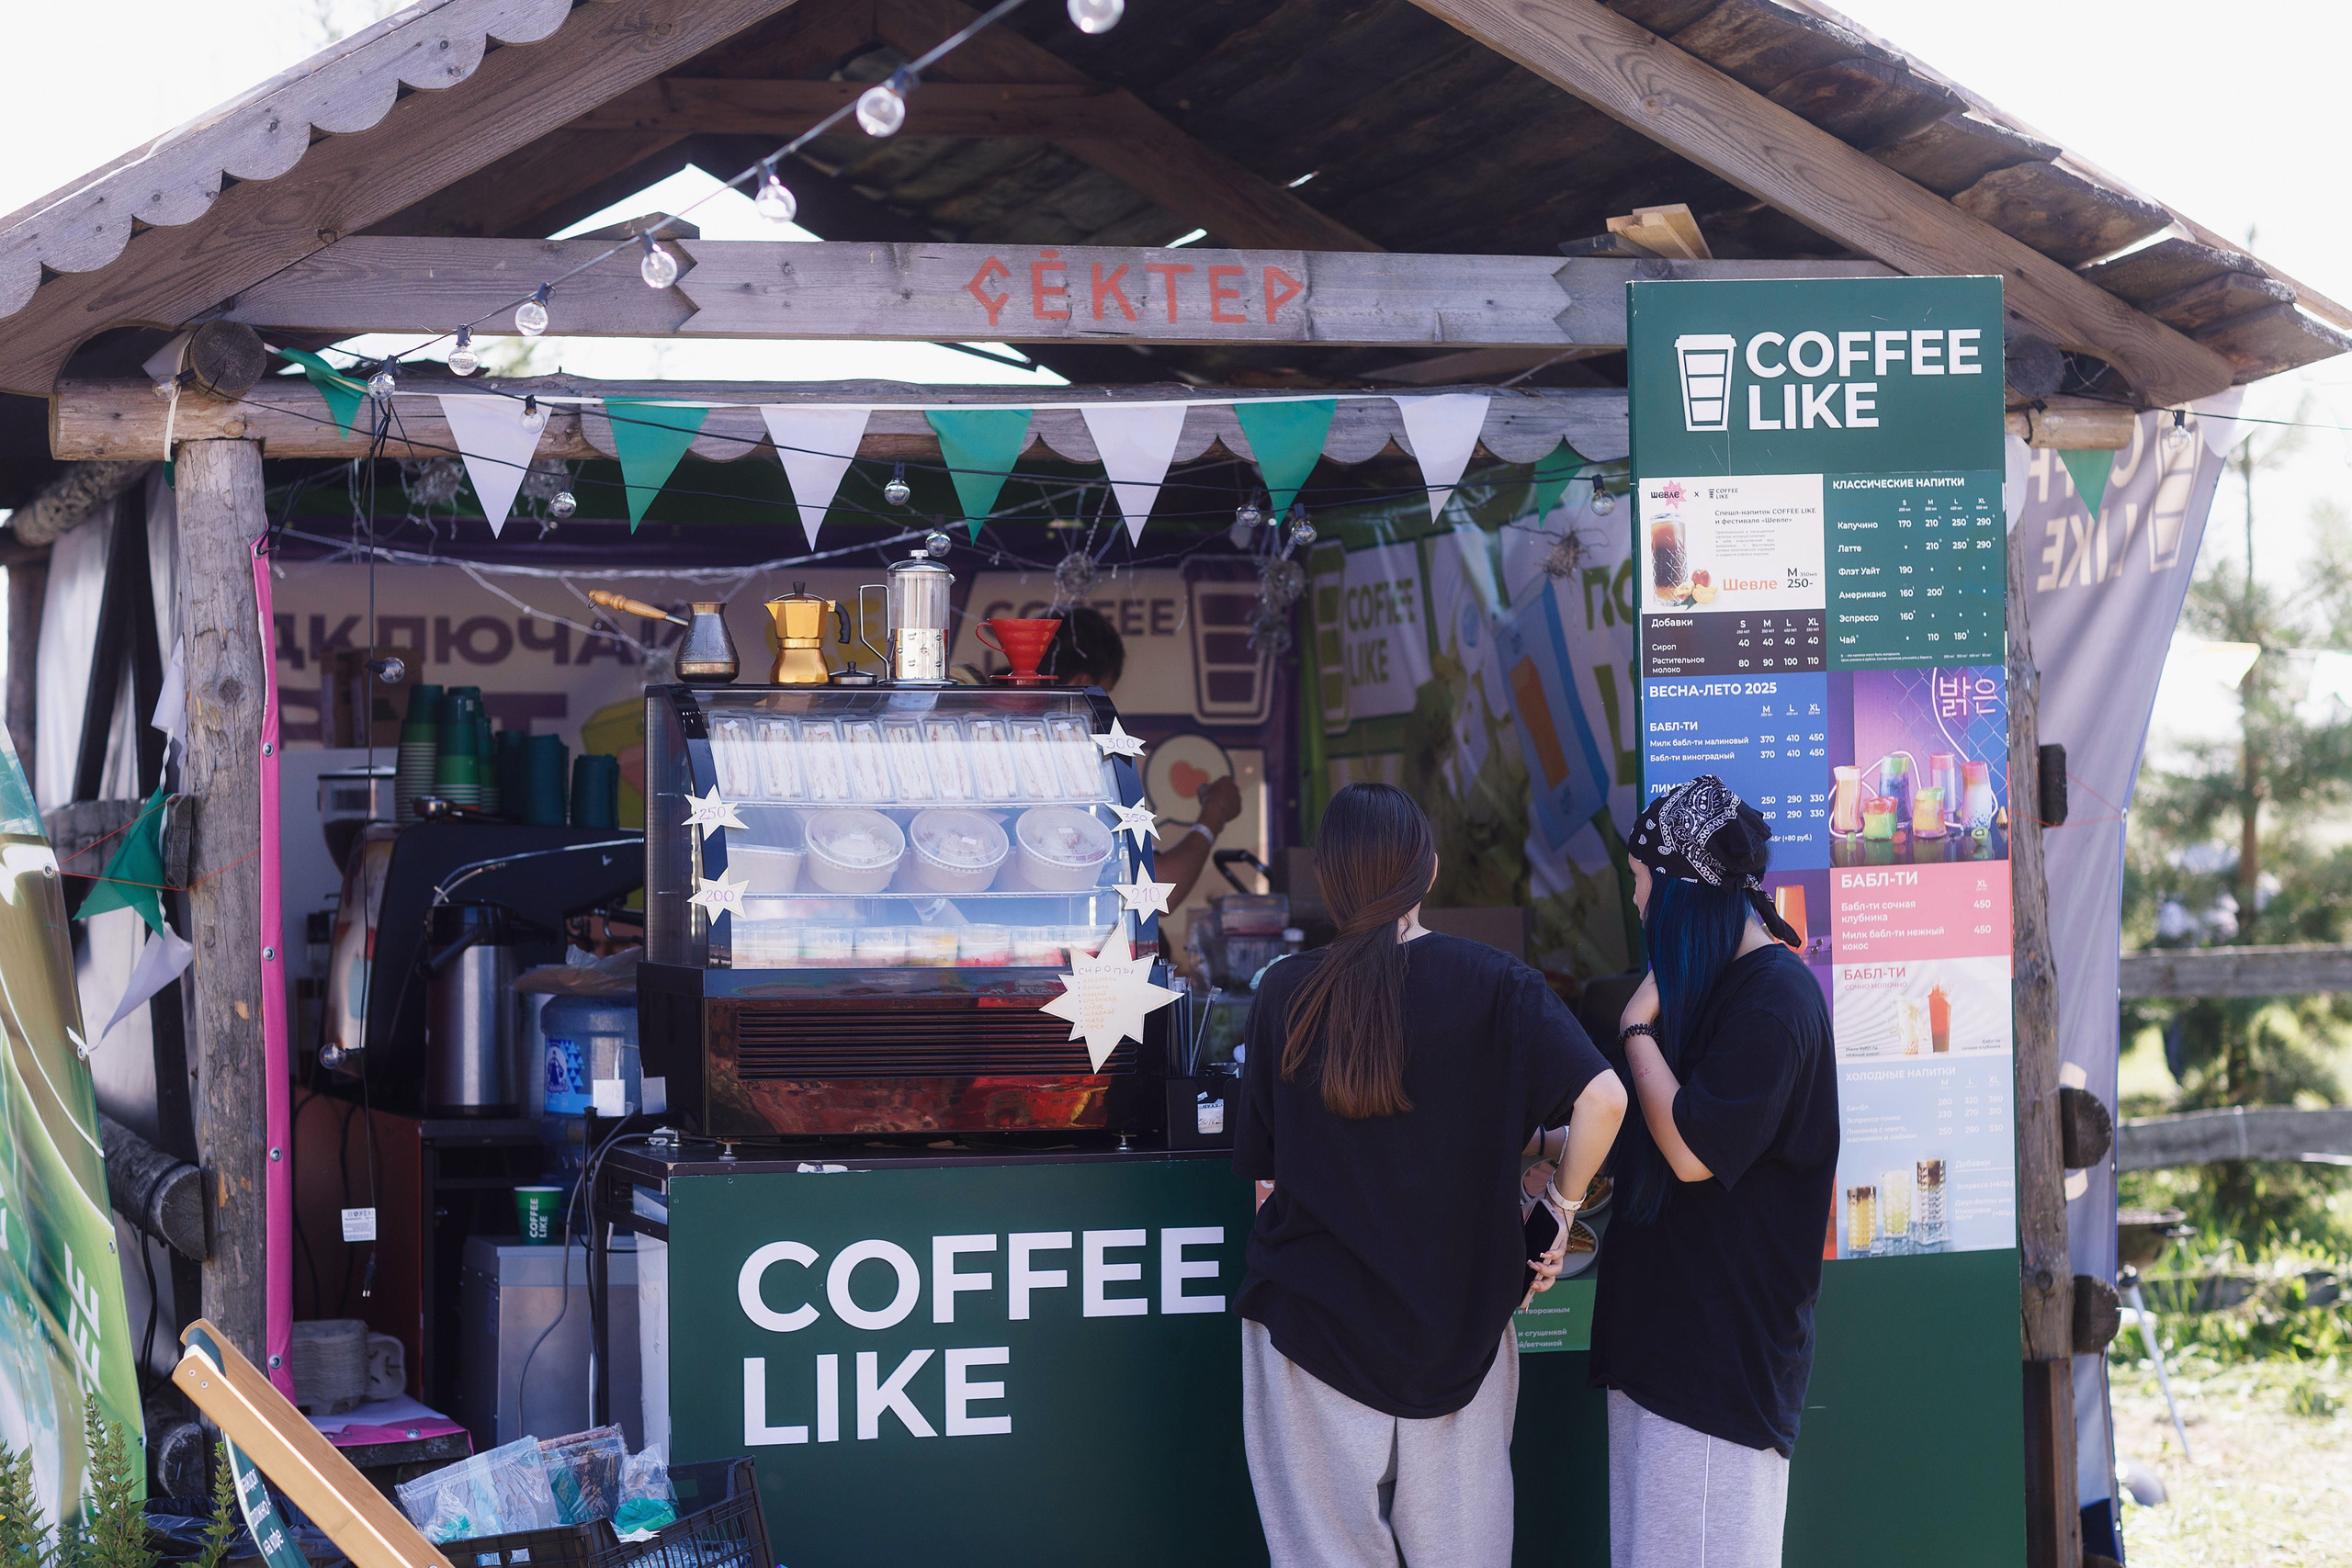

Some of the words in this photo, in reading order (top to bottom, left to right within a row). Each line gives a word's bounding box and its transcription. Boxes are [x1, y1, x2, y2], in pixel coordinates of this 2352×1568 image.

[1746, 329, 1983, 378] COFFEE
[1747, 382, 1880, 430] LIKE
[1832, 479, 1915, 490] КЛАССИЧЕСКИЕ
[1916, 477, 1965, 488] НАПИТКИ
[1838, 521, 1879, 530] Капучино
[1898, 520, 1912, 528] 170
[1838, 544, 1862, 553] Латте
[1838, 568, 1860, 576] Флэт
[1860, 567, 1881, 575] Уайт
[1899, 566, 1913, 574] 190
[1723, 578, 1778, 591] Шевле
[1838, 591, 1887, 600] Американо
[1651, 618, 1693, 629] Добавки
[1740, 620, 1746, 628] S
[1763, 619, 1771, 627] M
[1808, 618, 1819, 626] XL
[1839, 615, 1879, 623] Эспрессо
[1784, 637, 1795, 646] 40
[1807, 637, 1819, 645] 40
[1839, 635, 1856, 644] Чай
[1928, 633, 1939, 641] 110
[1652, 656, 1705, 664] Растительное
[1738, 660, 1749, 668] 80
[1783, 658, 1798, 666] 100
[1807, 657, 1819, 665] 110
[1649, 683, 1742, 698] ВЕСНА-ЛЕТО
[1745, 682, 1778, 694] 2025
[1649, 721, 1699, 732] БАБЛ-ТИ
[1104, 736, 1136, 750] 300
[1650, 739, 1671, 748] Милк
[1672, 738, 1703, 746] бабл-ти
[1704, 737, 1749, 745] малиновый
[1786, 734, 1800, 742] 410
[1809, 733, 1825, 741] 450
[1650, 753, 1681, 762] Бабл-ти
[1682, 752, 1736, 761] виноградный
[1759, 750, 1775, 759] 370
[1787, 750, 1801, 758] 410
[1809, 749, 1825, 757] 450
[1761, 795, 1776, 805] 250
[1786, 795, 1802, 804] 290
[1809, 794, 1825, 802] 330
[698, 805, 727, 821] 250
[1122, 810, 1148, 825] 350
[1762, 811, 1776, 819] 250
[1786, 810, 1802, 818] 290
[1809, 809, 1825, 818] 330
[1796, 833, 1812, 842] руб.)
[1841, 871, 1918, 888] БАБЛ-ТИ
[1976, 879, 1987, 887] XL
[705, 887, 735, 903] 200
[1131, 886, 1161, 906] 210
[1841, 902, 1880, 911] Бабл-ти
[1882, 900, 1917, 909] сочная
[1973, 899, 1991, 908] 450
[1841, 913, 1888, 923] клубника
[1842, 931, 1868, 940] Милк
[1869, 930, 1905, 939] бабл-ти
[1906, 927, 1945, 937] нежный
[1973, 925, 1992, 934] 450
[1842, 942, 1869, 951] кокос
[1843, 967, 1906, 981] БАБЛ-ТИ
[1846, 1070, 1905, 1081] ХОЛОДНЫЕ
[1907, 1067, 1956, 1077] НАПИТКИ
[1847, 1114, 1901, 1124] Эспрессо-тоник
[1846, 1127, 1878, 1136] Лимонад
[1955, 1159, 1991, 1168] Добавки
[529, 1198, 539, 1238] COFFEE
[538, 1215, 548, 1238] LIKE
[737, 1225, 1227, 1334] COFFEE
[1525, 1328, 1567, 1337] сгущенкой
[1519, 1340, 1563, 1348] й/ветчиной
[742, 1346, 1013, 1448] LIKE
